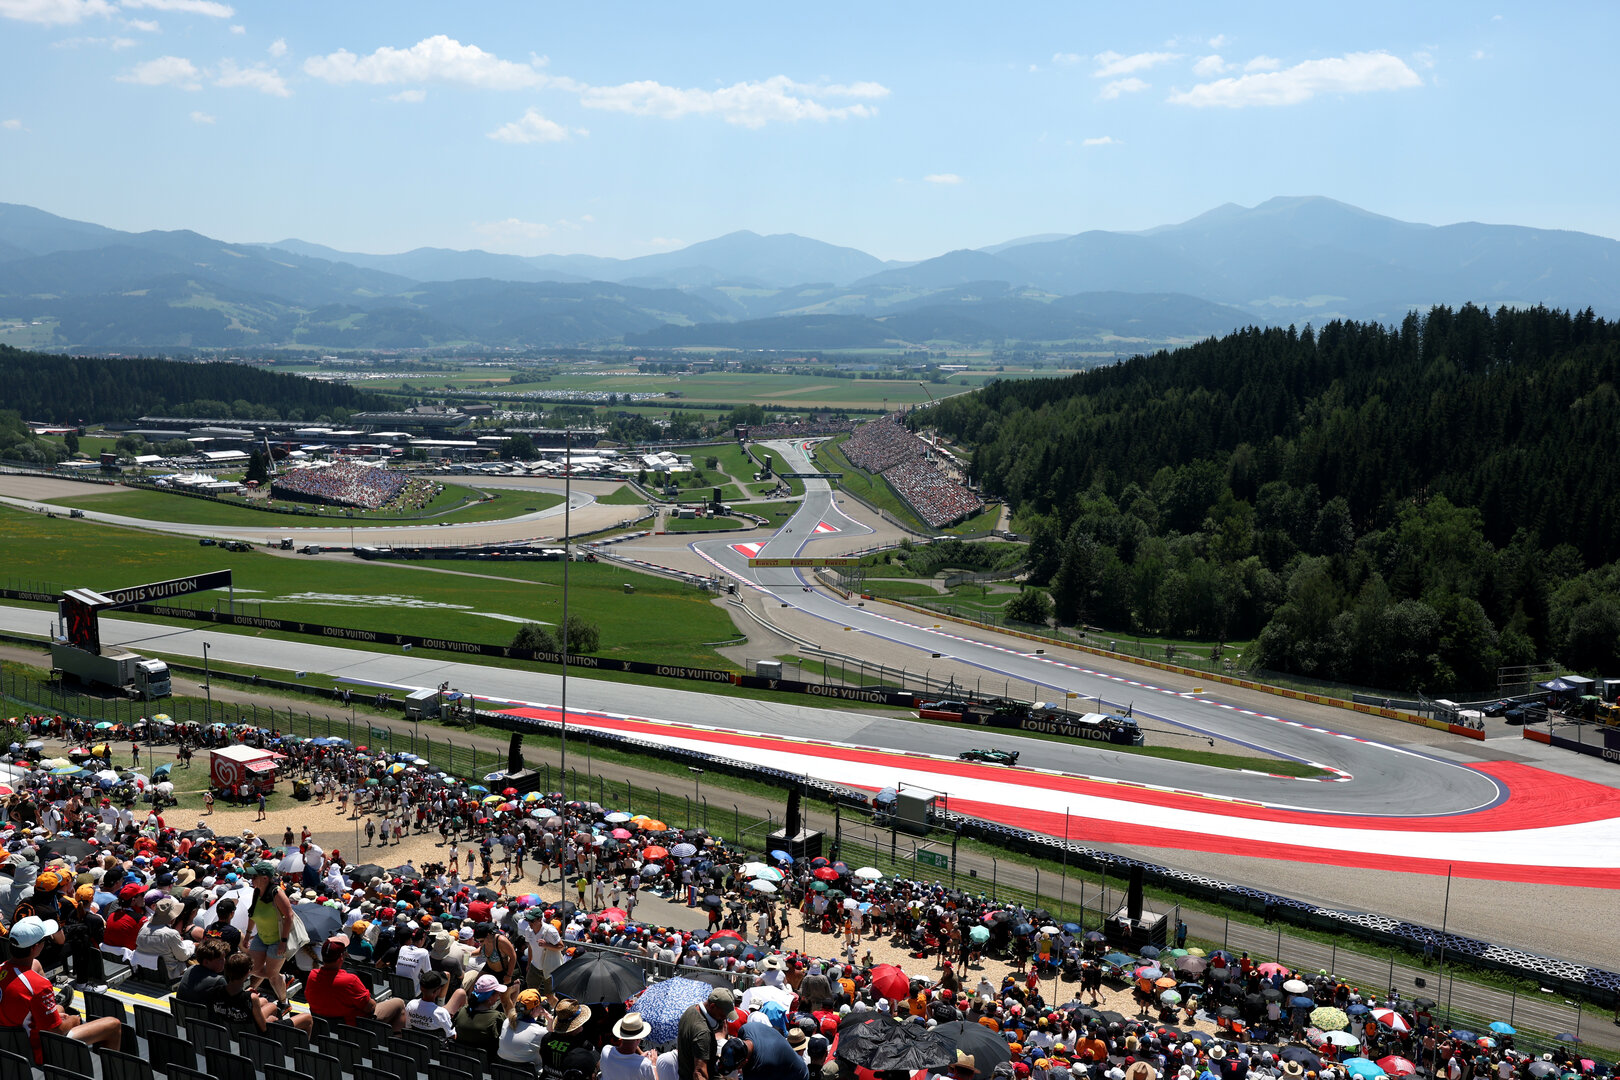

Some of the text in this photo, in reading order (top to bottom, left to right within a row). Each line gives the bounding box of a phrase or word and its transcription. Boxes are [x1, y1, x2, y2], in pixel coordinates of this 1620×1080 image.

[110, 579, 197, 604] LOUIS VUITTON
[154, 606, 196, 618] LOUIS VUITTON
[234, 616, 281, 628] LOUIS VUITTON
[323, 626, 376, 640] LOUIS VUITTON
[423, 639, 446, 649] LOUIS
[448, 642, 480, 653] VUITTON
[534, 651, 559, 662] LOUIS
[657, 666, 729, 682] LOUIS VUITTON
[807, 684, 887, 704] LOUIS VUITTON
[1022, 720, 1111, 741] LOUIS VUITTON
[548, 1040, 570, 1052] 46
